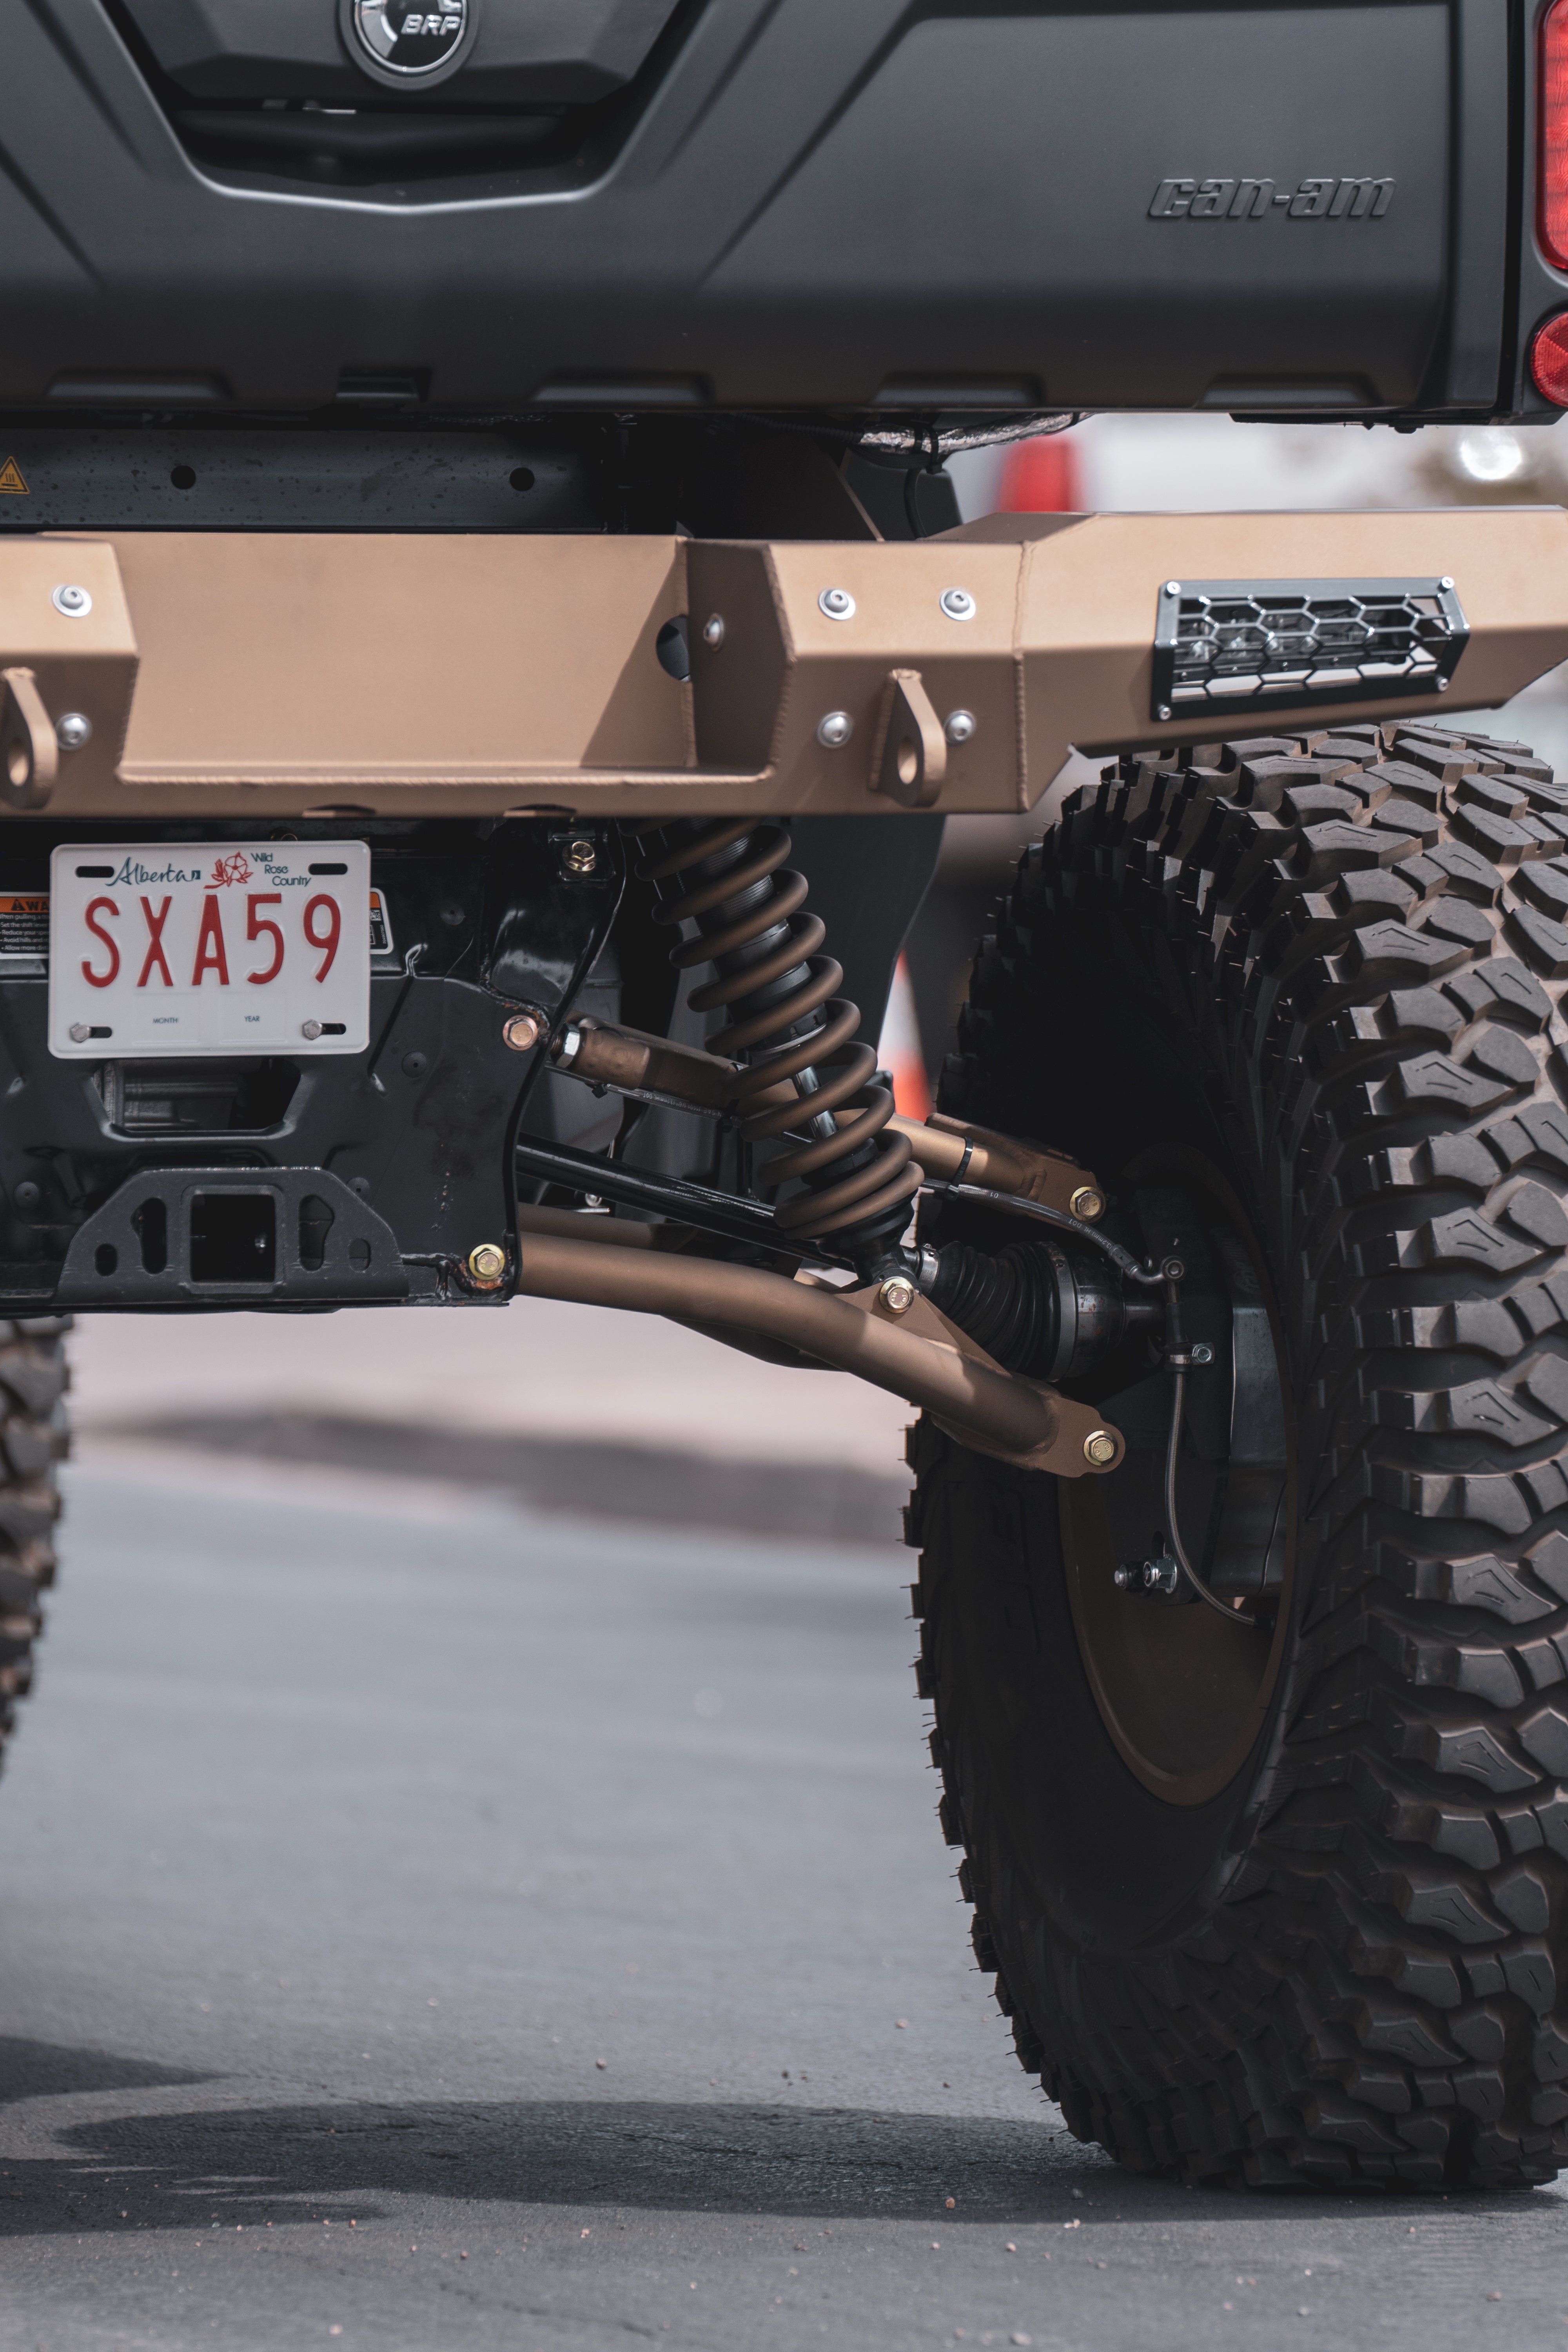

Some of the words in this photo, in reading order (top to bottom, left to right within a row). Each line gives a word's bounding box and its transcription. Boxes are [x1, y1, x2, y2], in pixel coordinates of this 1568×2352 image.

[401, 14, 461, 36] BRP
[1148, 178, 1396, 218] can-am
[251, 852, 273, 862] Wild
[105, 857, 193, 886] Alberta
[264, 864, 289, 874] Rose
[272, 875, 311, 887] Country
[81, 893, 341, 988] SXA59
[1068, 1218, 1082, 1229] DOT
[1083, 1226, 1091, 1234] HL
